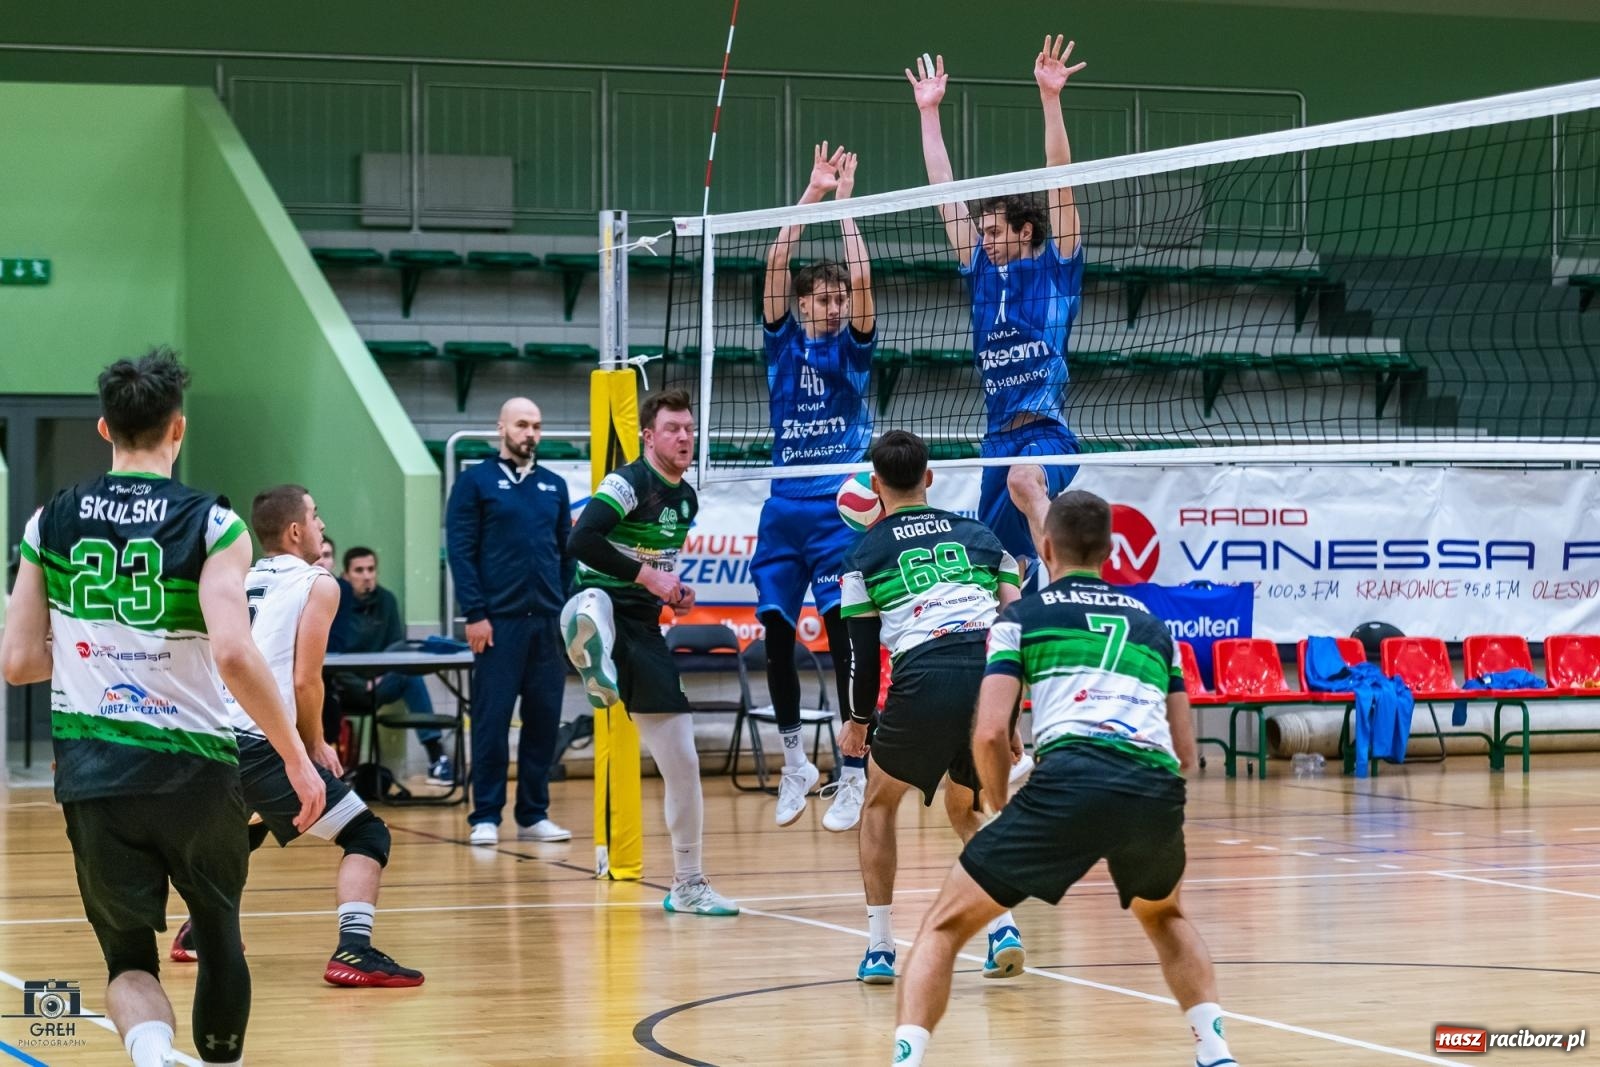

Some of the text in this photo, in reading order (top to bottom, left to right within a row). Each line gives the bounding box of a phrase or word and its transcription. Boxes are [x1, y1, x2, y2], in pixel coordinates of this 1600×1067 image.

[79, 495, 168, 524] SKULSKI
[1179, 508, 1308, 527] RADIO
[892, 519, 952, 541] ROBCIO
[681, 535, 757, 555] MULT
[1179, 540, 1535, 571] VANESSA
[679, 559, 755, 584] ZENI
[817, 574, 840, 584] KML
[897, 541, 973, 595] 69
[70, 538, 165, 625] 23
[1268, 585, 1308, 601] 100,3
[1312, 581, 1340, 601] FM
[1356, 579, 1462, 601] KRAPKOWICE
[1464, 583, 1491, 598] 95,8
[1495, 580, 1521, 600] FM
[1532, 580, 1599, 600] OLESNO
[1164, 616, 1239, 638] molten
[1085, 613, 1131, 672] 7
